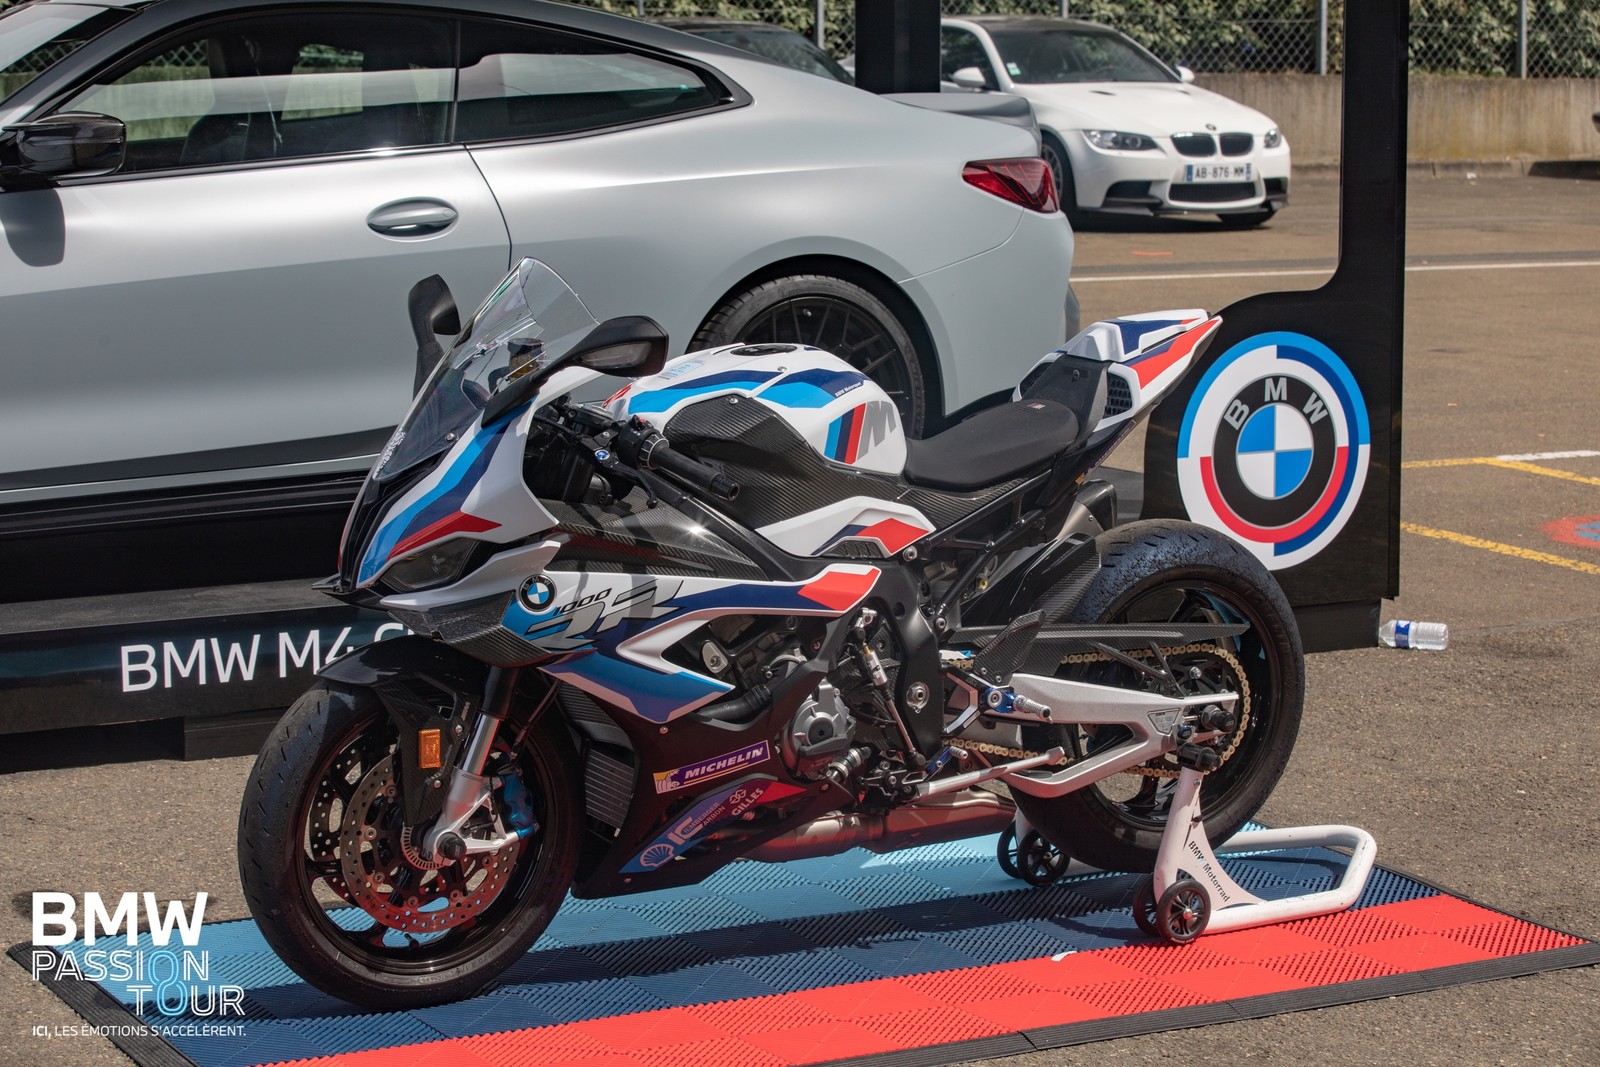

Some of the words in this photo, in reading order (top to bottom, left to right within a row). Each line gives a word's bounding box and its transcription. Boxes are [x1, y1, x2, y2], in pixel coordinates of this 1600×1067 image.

[1223, 377, 1329, 430] BMW
[521, 576, 552, 592] BMW
[121, 633, 261, 693] BMW
[684, 746, 764, 779] MICHELIN
[731, 787, 764, 816] GILLES
[1202, 863, 1231, 902] Motorrad
